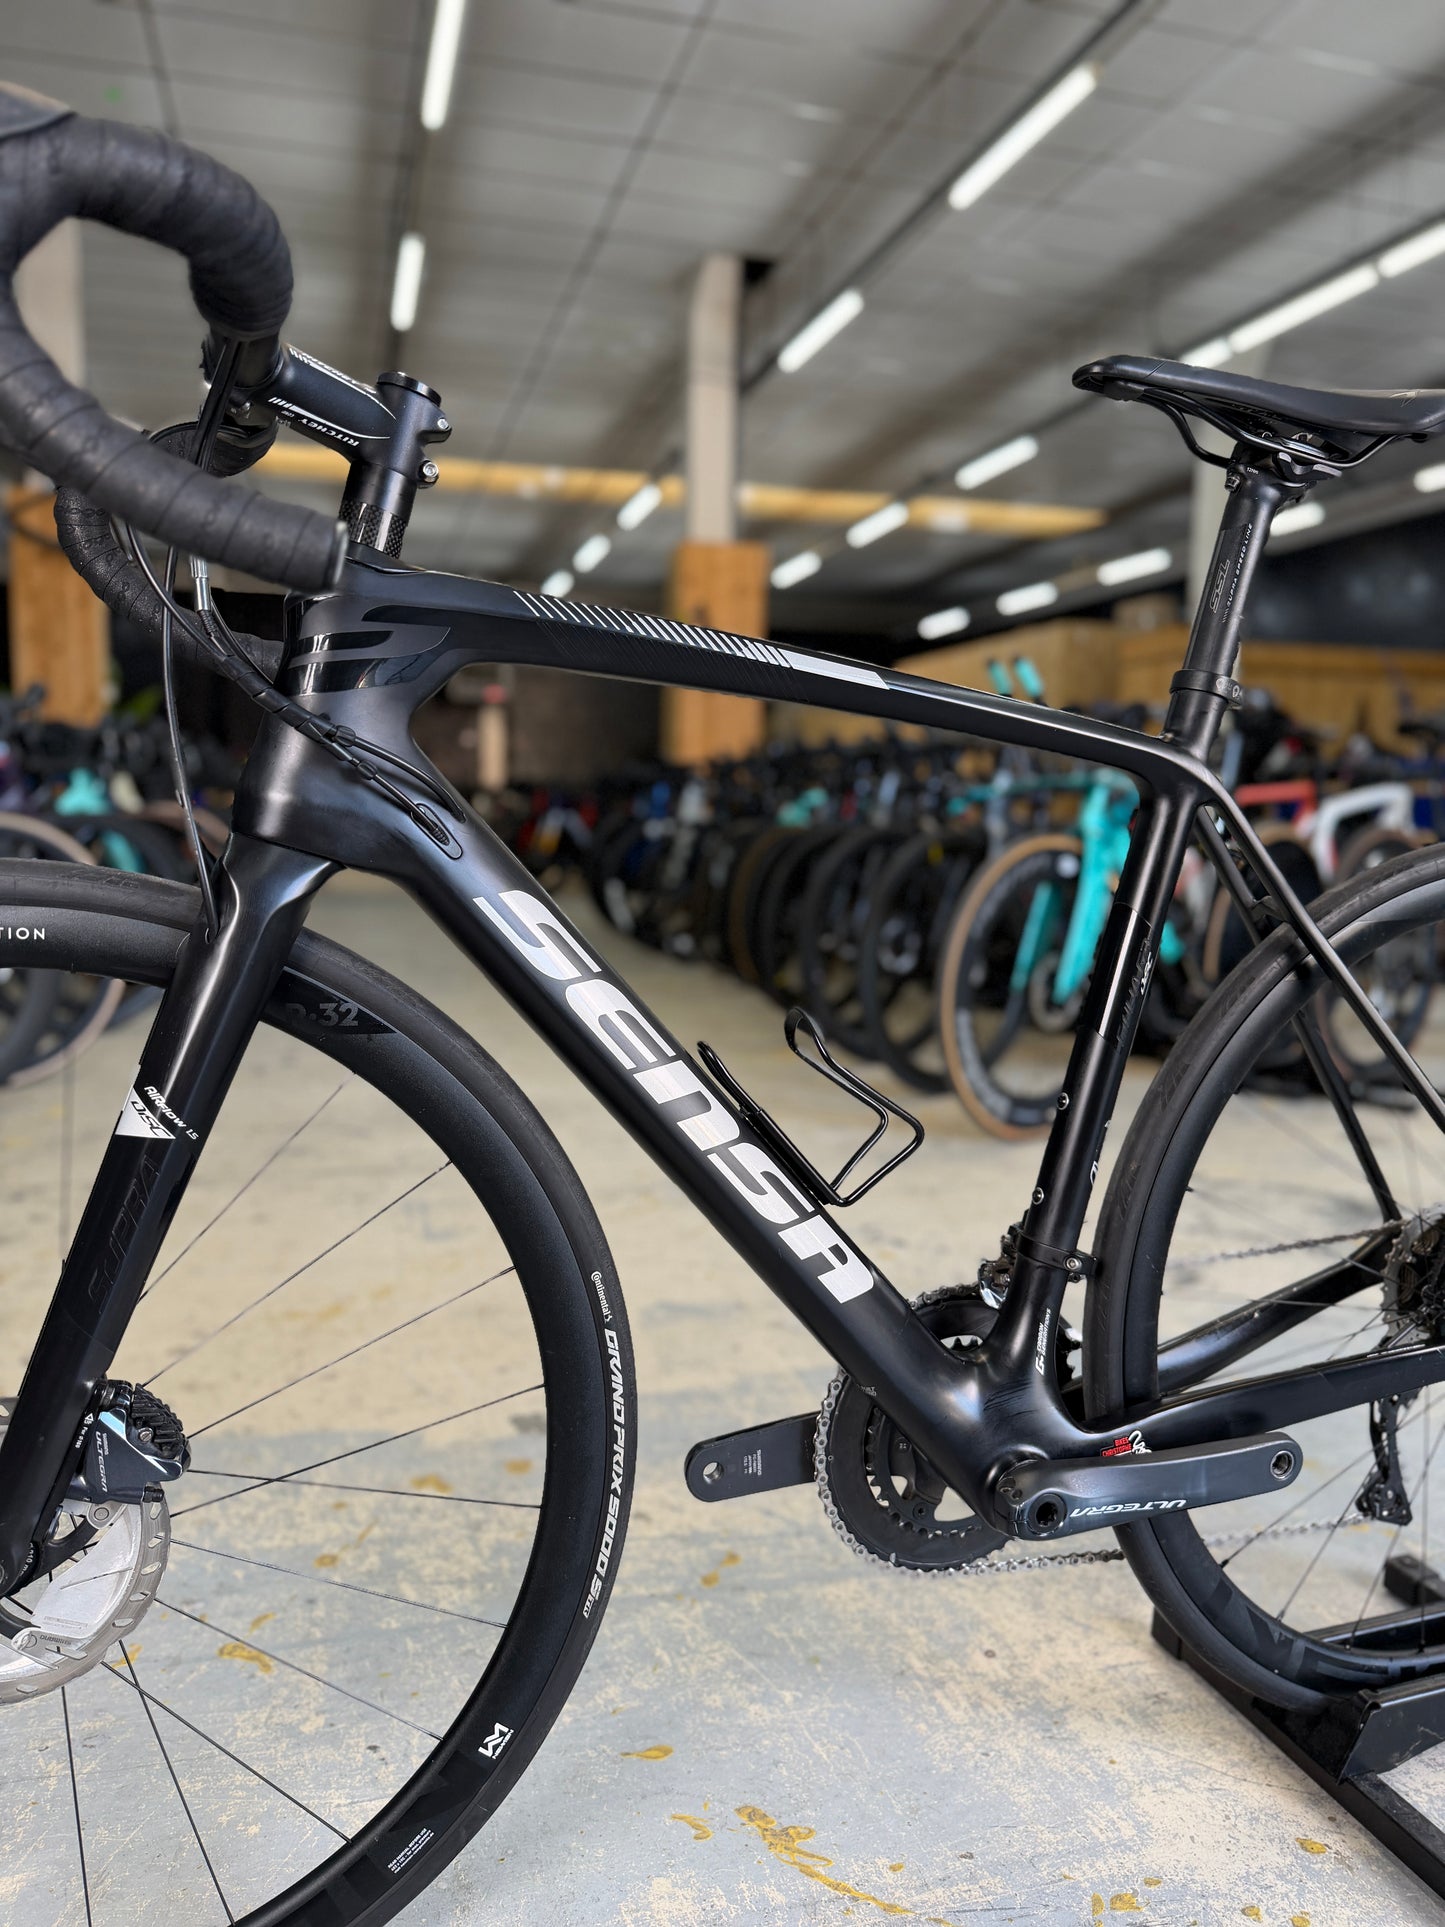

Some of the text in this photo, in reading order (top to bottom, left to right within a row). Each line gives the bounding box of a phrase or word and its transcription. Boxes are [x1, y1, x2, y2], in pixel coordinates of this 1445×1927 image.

[298, 417, 360, 447] RITCHEY
[1235, 545, 1247, 576] SPEED
[1244, 523, 1253, 545] LINE
[590, 1270, 609, 1317] Continental
[605, 1329, 626, 1425] GRAND
[95, 1431, 108, 1493] ULTEGRA
[611, 1425, 625, 1496] PRIX
[1115, 1436, 1129, 1447] BIKES
[1070, 1499, 1187, 1518] ULTEGRA
[596, 1493, 620, 1578] 5000
